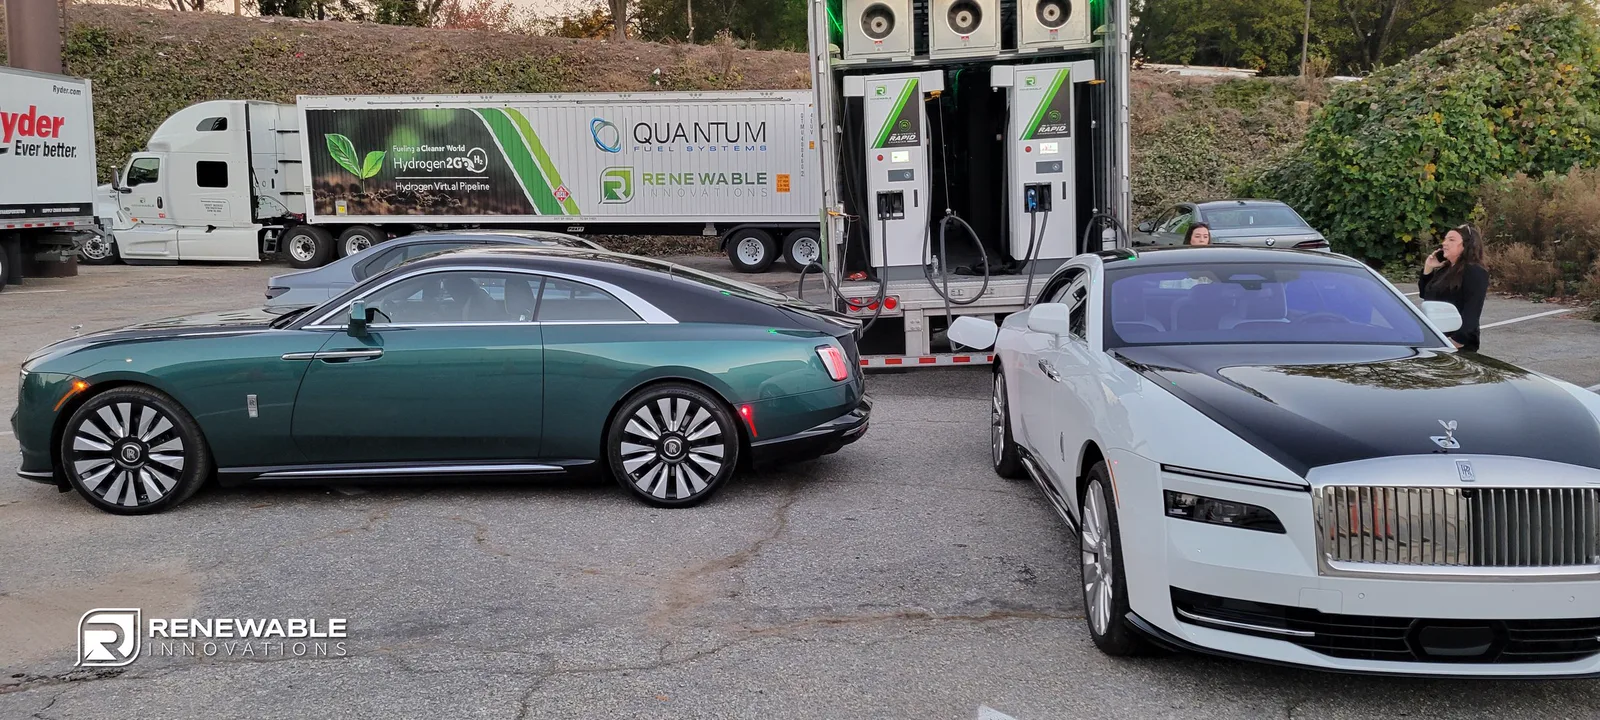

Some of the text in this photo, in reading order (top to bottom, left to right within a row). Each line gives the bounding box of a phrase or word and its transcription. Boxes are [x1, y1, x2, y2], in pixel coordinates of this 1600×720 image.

[52, 84, 82, 95] Ryder.com
[0, 104, 65, 144] yder
[1038, 125, 1067, 133] RAPID
[633, 121, 767, 145] QUANTUM
[889, 134, 916, 142] RAPID
[15, 139, 77, 158] Ever better.
[392, 145, 415, 154] Fueling
[421, 144, 445, 152] Cleaner
[446, 144, 466, 152] World
[642, 172, 767, 186] RENEWABLE
[395, 181, 490, 193] Hydrogen Virtual Pipeline
[642, 187, 768, 197] INNOVATIONS
